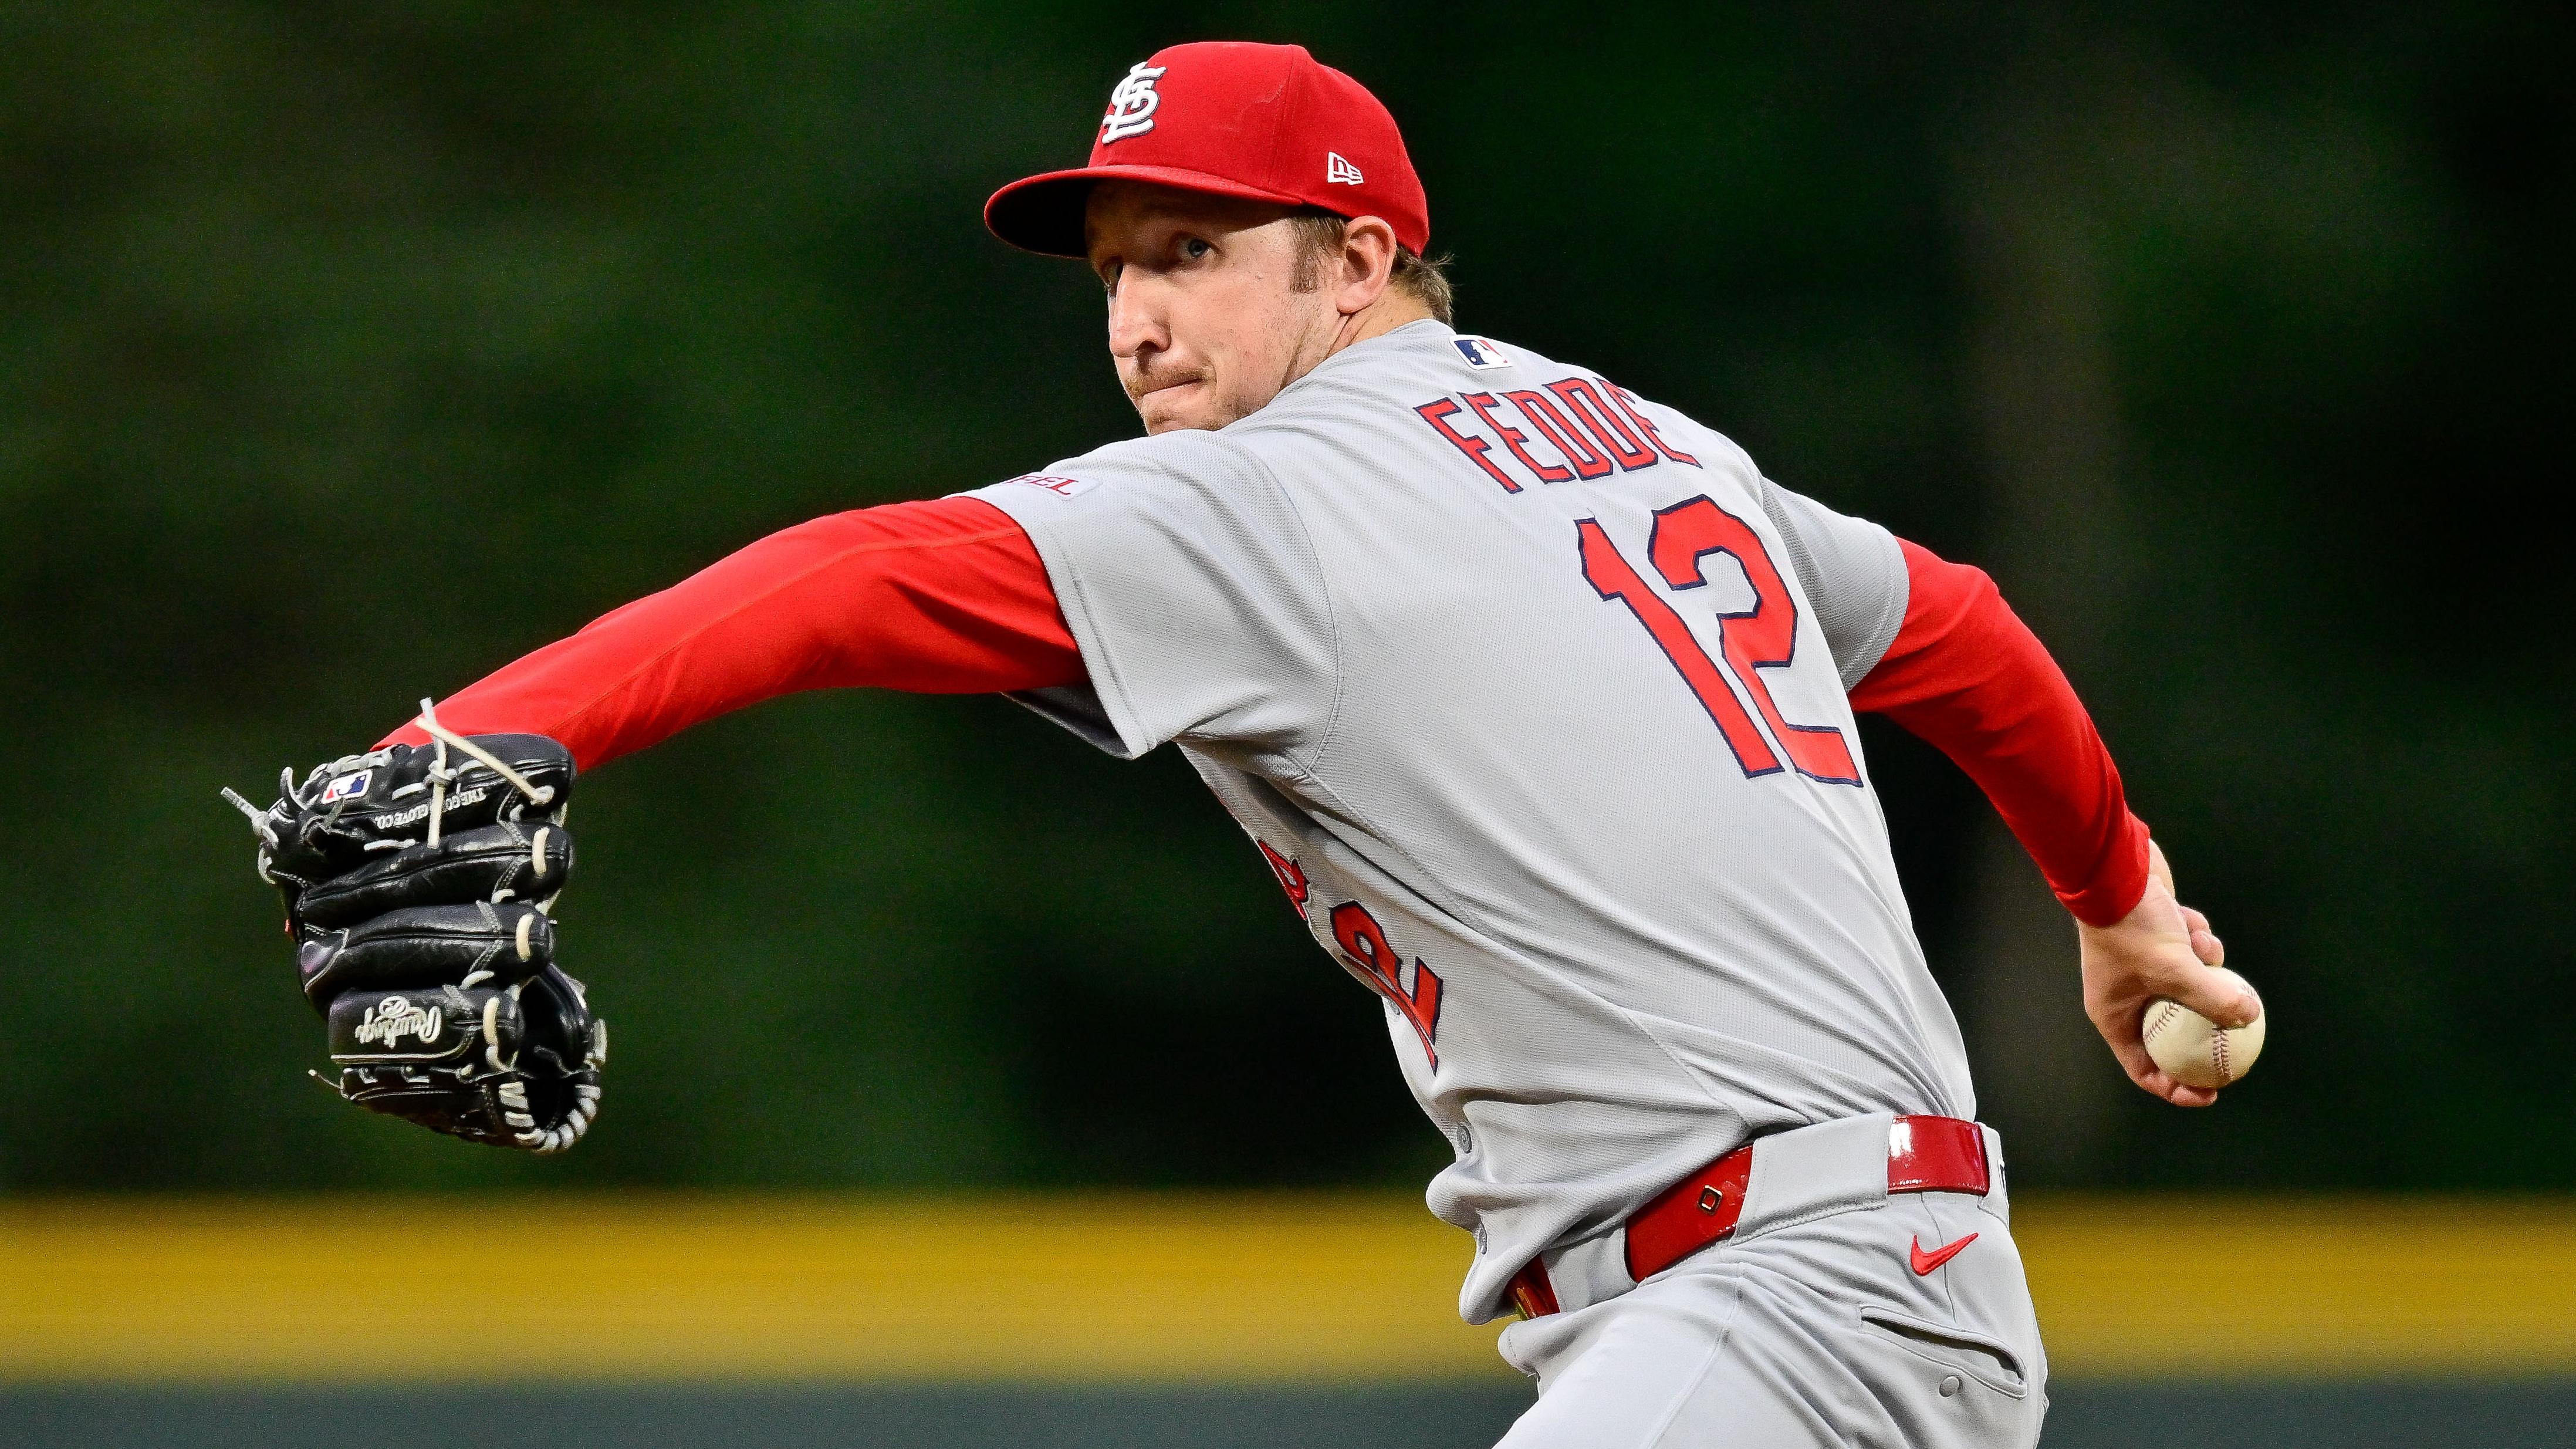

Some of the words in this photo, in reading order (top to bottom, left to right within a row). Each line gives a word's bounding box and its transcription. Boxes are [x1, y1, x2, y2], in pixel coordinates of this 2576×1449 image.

[1413, 377, 1703, 494] FEDDE
[1574, 494, 1864, 788] 12
[442, 795, 461, 812] GO
[460, 788, 486, 805] THE
